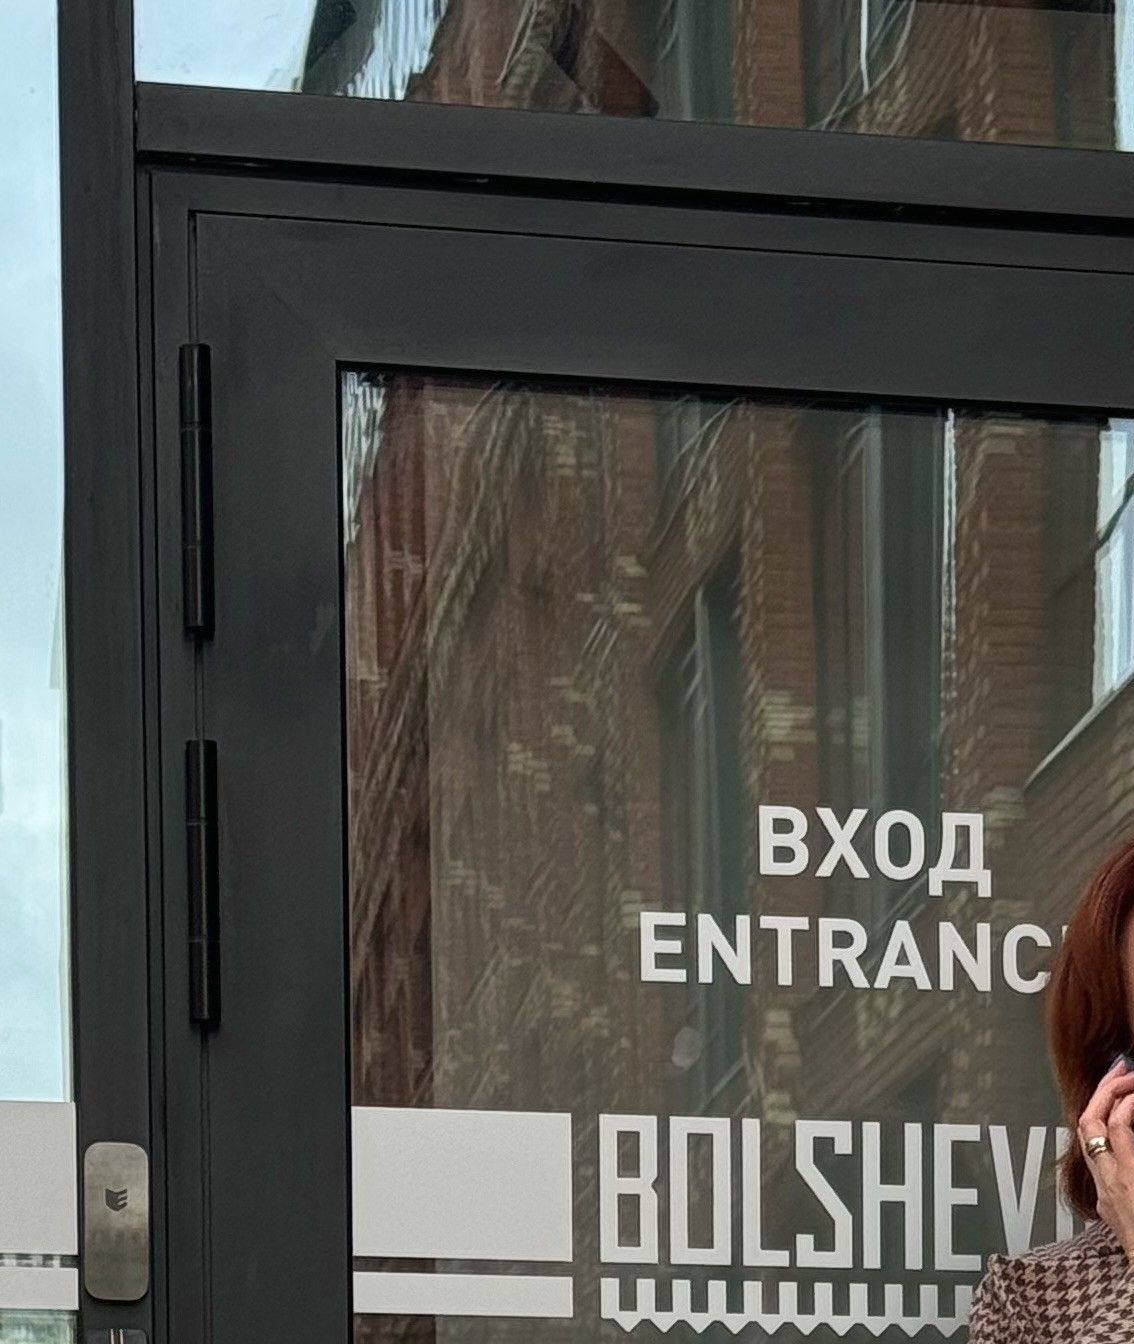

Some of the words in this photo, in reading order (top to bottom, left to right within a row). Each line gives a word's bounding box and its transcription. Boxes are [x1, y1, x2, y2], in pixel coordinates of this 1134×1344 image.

[758, 805, 992, 898] ВХОД
[639, 911, 1069, 994] ENTRANC
[599, 1113, 1096, 1272] BOLSHEVI
